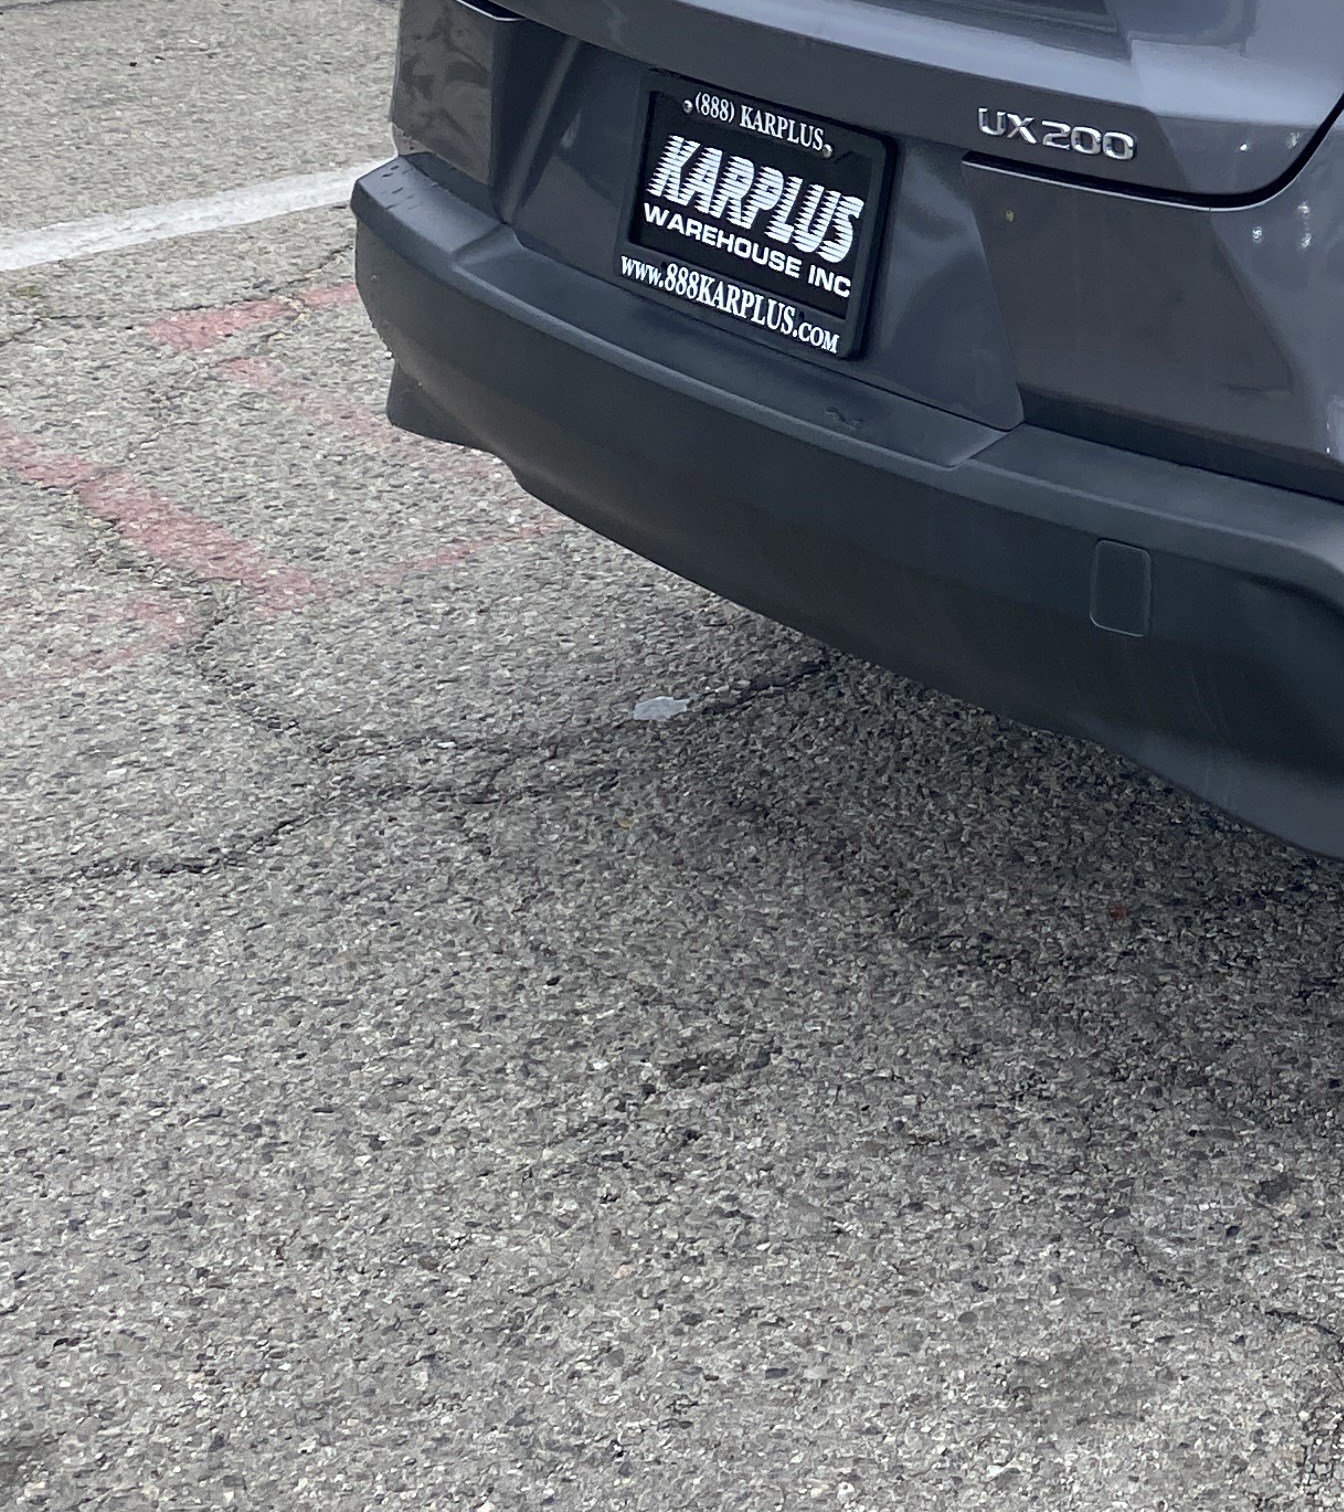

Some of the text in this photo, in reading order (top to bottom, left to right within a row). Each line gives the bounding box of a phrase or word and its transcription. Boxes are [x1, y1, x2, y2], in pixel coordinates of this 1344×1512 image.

[695, 92, 825, 151] (888) KARPLUS
[647, 135, 865, 264] KARPLUS
[643, 202, 852, 299] WAREHOUSE INC
